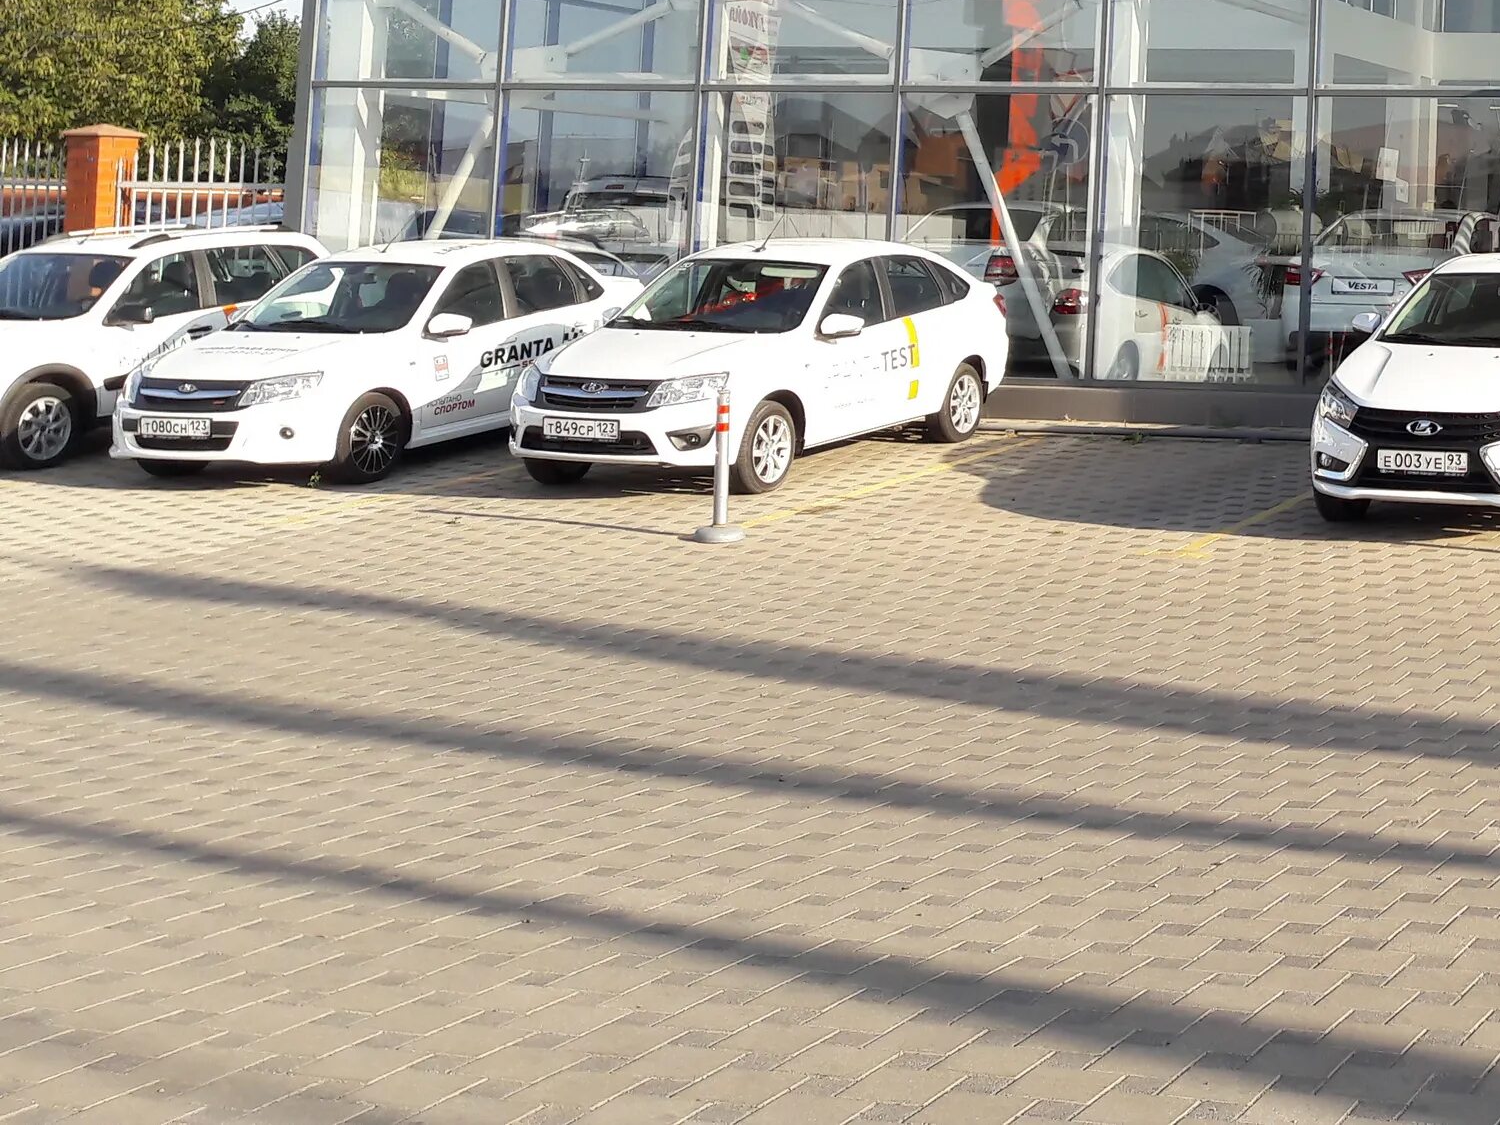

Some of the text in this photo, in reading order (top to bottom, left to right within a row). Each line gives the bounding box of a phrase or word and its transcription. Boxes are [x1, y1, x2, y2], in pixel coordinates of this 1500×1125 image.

[1347, 281, 1379, 290] VESTA
[480, 337, 555, 369] GRANTA
[881, 344, 916, 372] TEST
[434, 399, 476, 416] СПОРТОМ
[189, 420, 207, 431] 123
[596, 422, 615, 434] 123
[1447, 454, 1462, 466] 93
